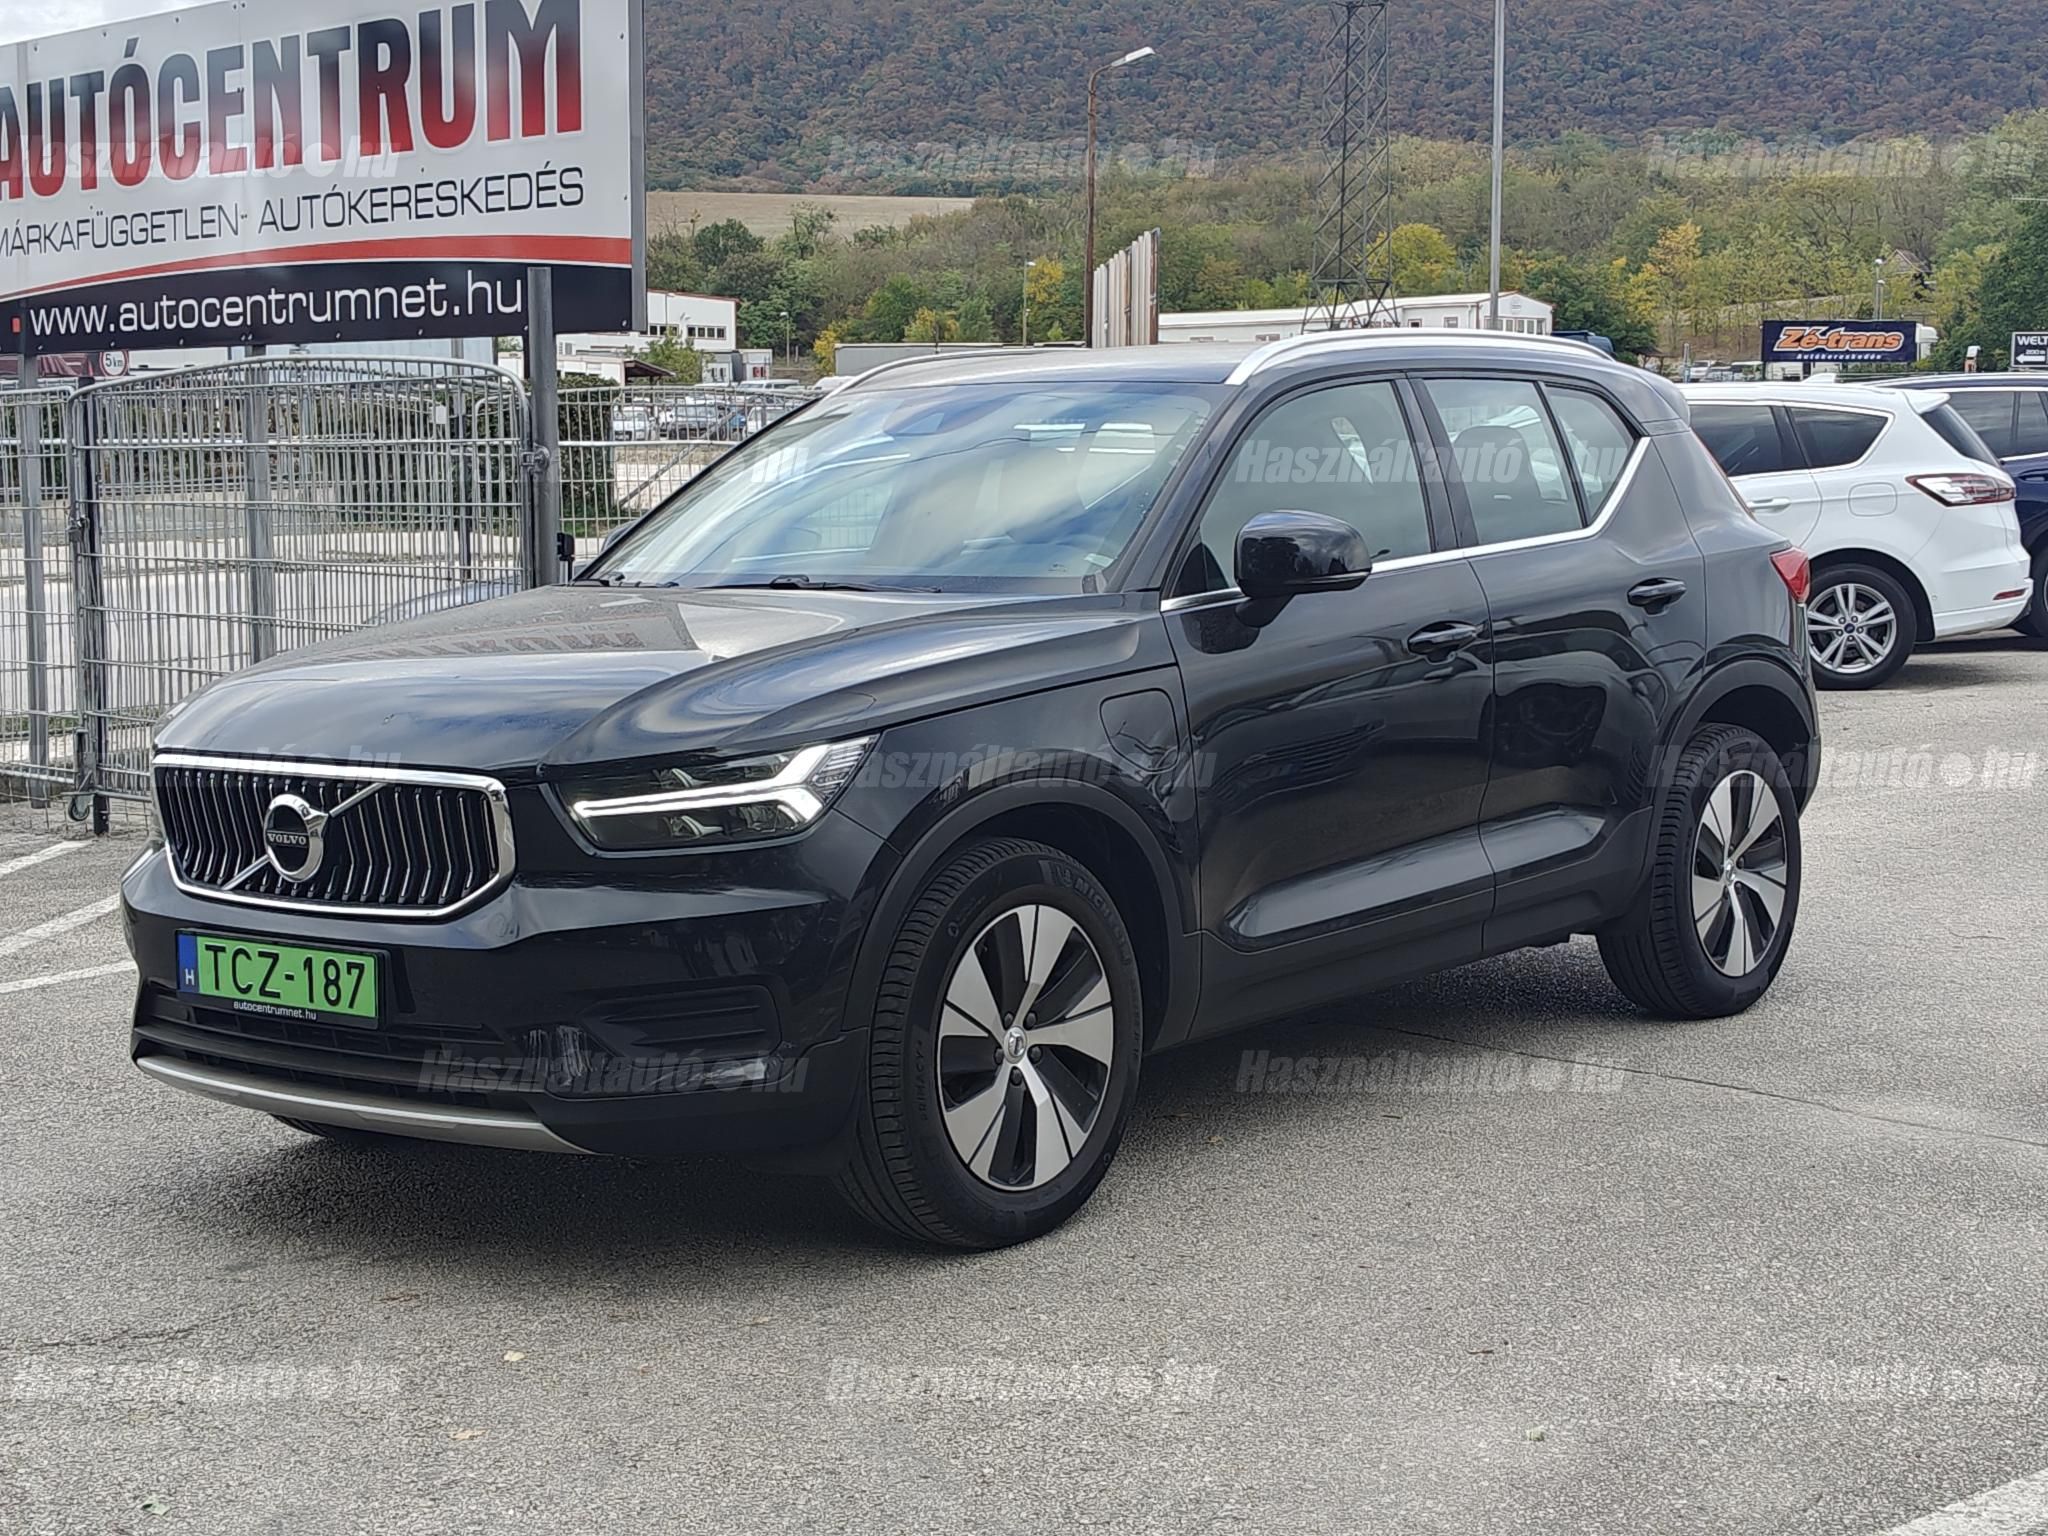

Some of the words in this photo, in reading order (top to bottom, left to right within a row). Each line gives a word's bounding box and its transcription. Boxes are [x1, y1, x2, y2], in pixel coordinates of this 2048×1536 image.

[0, 0, 582, 199] AUTÓCENTRUM
[258, 161, 584, 234] AUTÓKERESKEDÉS
[30, 270, 522, 336] www.autocentrumnet.hu
[1776, 327, 1902, 351] Zé-trans
[105, 353, 112, 367] 5
[267, 833, 307, 845] VOLVO
[185, 968, 194, 986] H
[205, 943, 365, 1009] TCZ-187
[233, 1000, 317, 1020] autocentrumnet.hu
